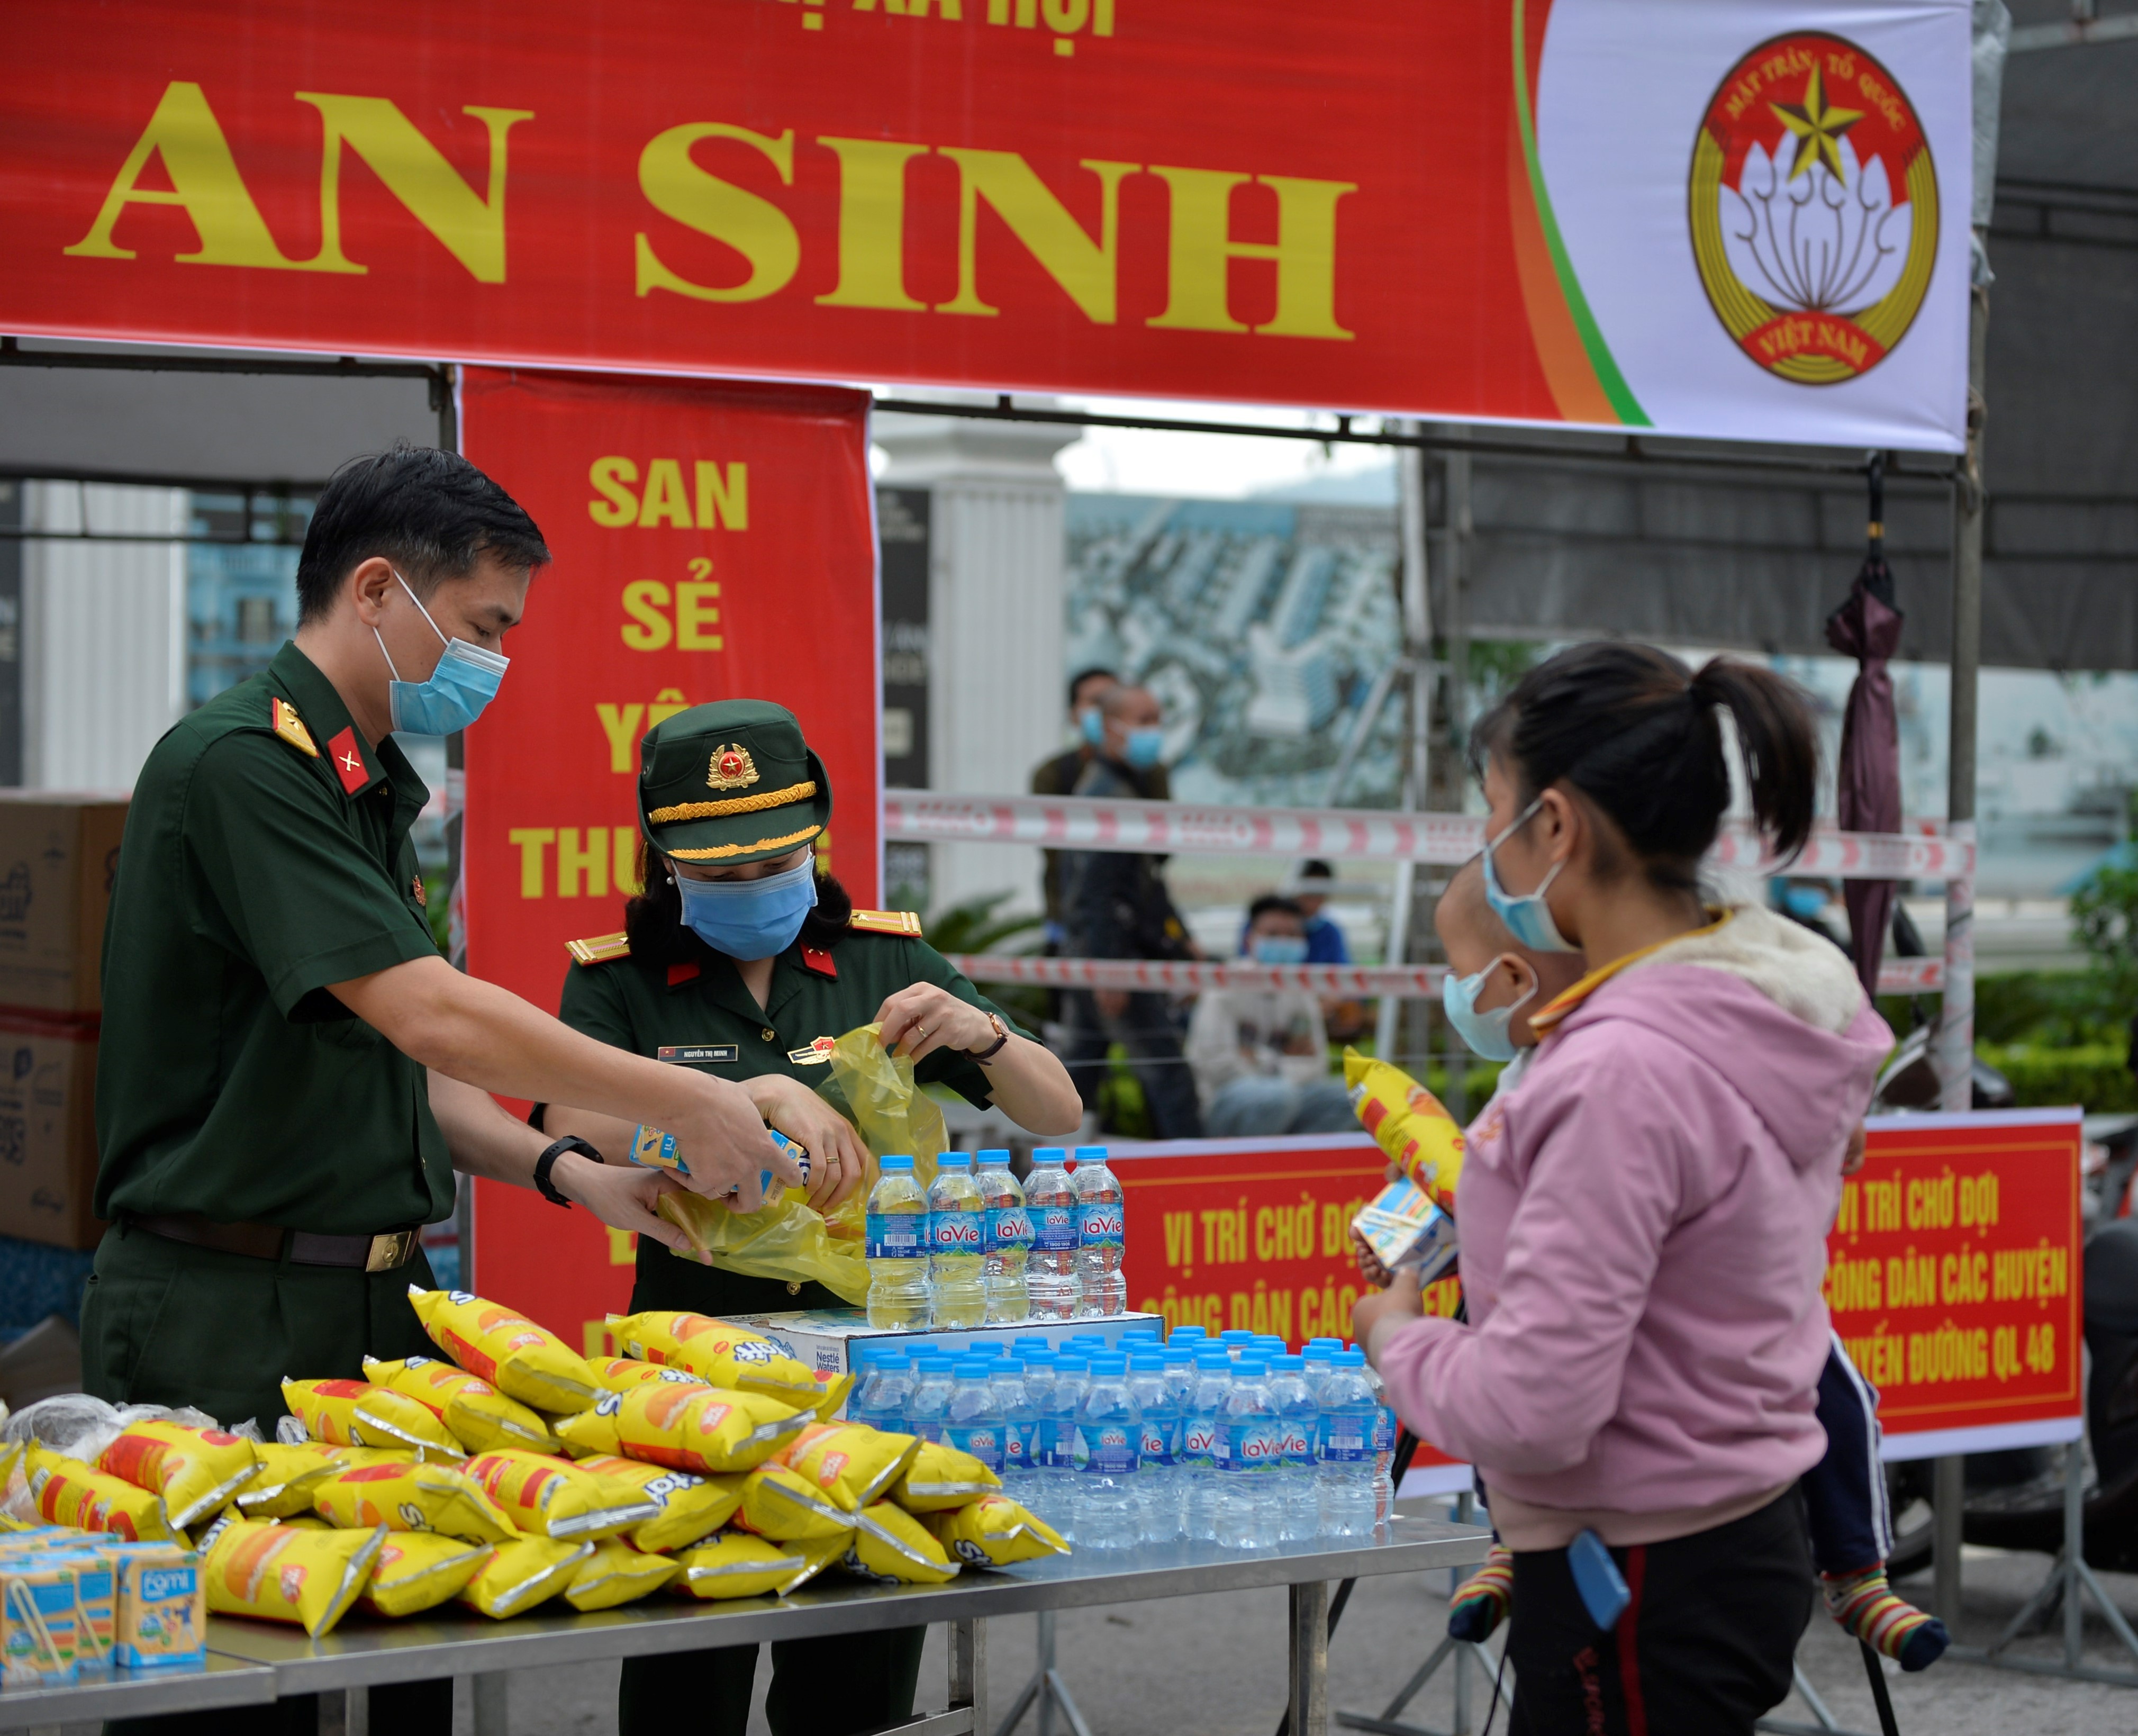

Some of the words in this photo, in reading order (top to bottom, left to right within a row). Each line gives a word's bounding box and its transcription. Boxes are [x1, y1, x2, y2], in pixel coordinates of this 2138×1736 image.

[62, 80, 534, 284] AN
[635, 121, 1358, 341] SINH
[1816, 322, 1869, 365] NAM
[588, 455, 749, 531] SAN
[621, 557, 724, 651] SẺ
[1864, 1168, 1901, 1232] TRÍ
[1908, 1165, 1955, 1231] CHỜ
[1960, 1170, 1999, 1237] ĐỢI
[936, 1225, 979, 1243] laVie
[1046, 1215, 1069, 1225] laVie
[1083, 1217, 1122, 1234] laVie
[1164, 1211, 1194, 1278] VỊ
[1201, 1196, 1249, 1265] TRÍ
[1256, 1191, 1316, 1260] CHỜ
[1320, 1195, 1366, 1267] ĐỢ
[1888, 1245, 1936, 1308] DÂN
[1942, 1242, 1988, 1304] CÁC
[1994, 1236, 2067, 1309] HUYỆN
[1230, 1280, 1292, 1343] DÂN
[1300, 1274, 1358, 1340] CÁC
[816, 1351, 839, 1363] Nestlé
[1994, 1325, 2022, 1382] QL
[2026, 1322, 2055, 1374] 48
[816, 1362, 840, 1373] Waters
[971, 1436, 994, 1448] laVie
[1101, 1434, 1127, 1445] laVie
[1186, 1432, 1215, 1450] laV
[1243, 1439, 1281, 1457] laVie
